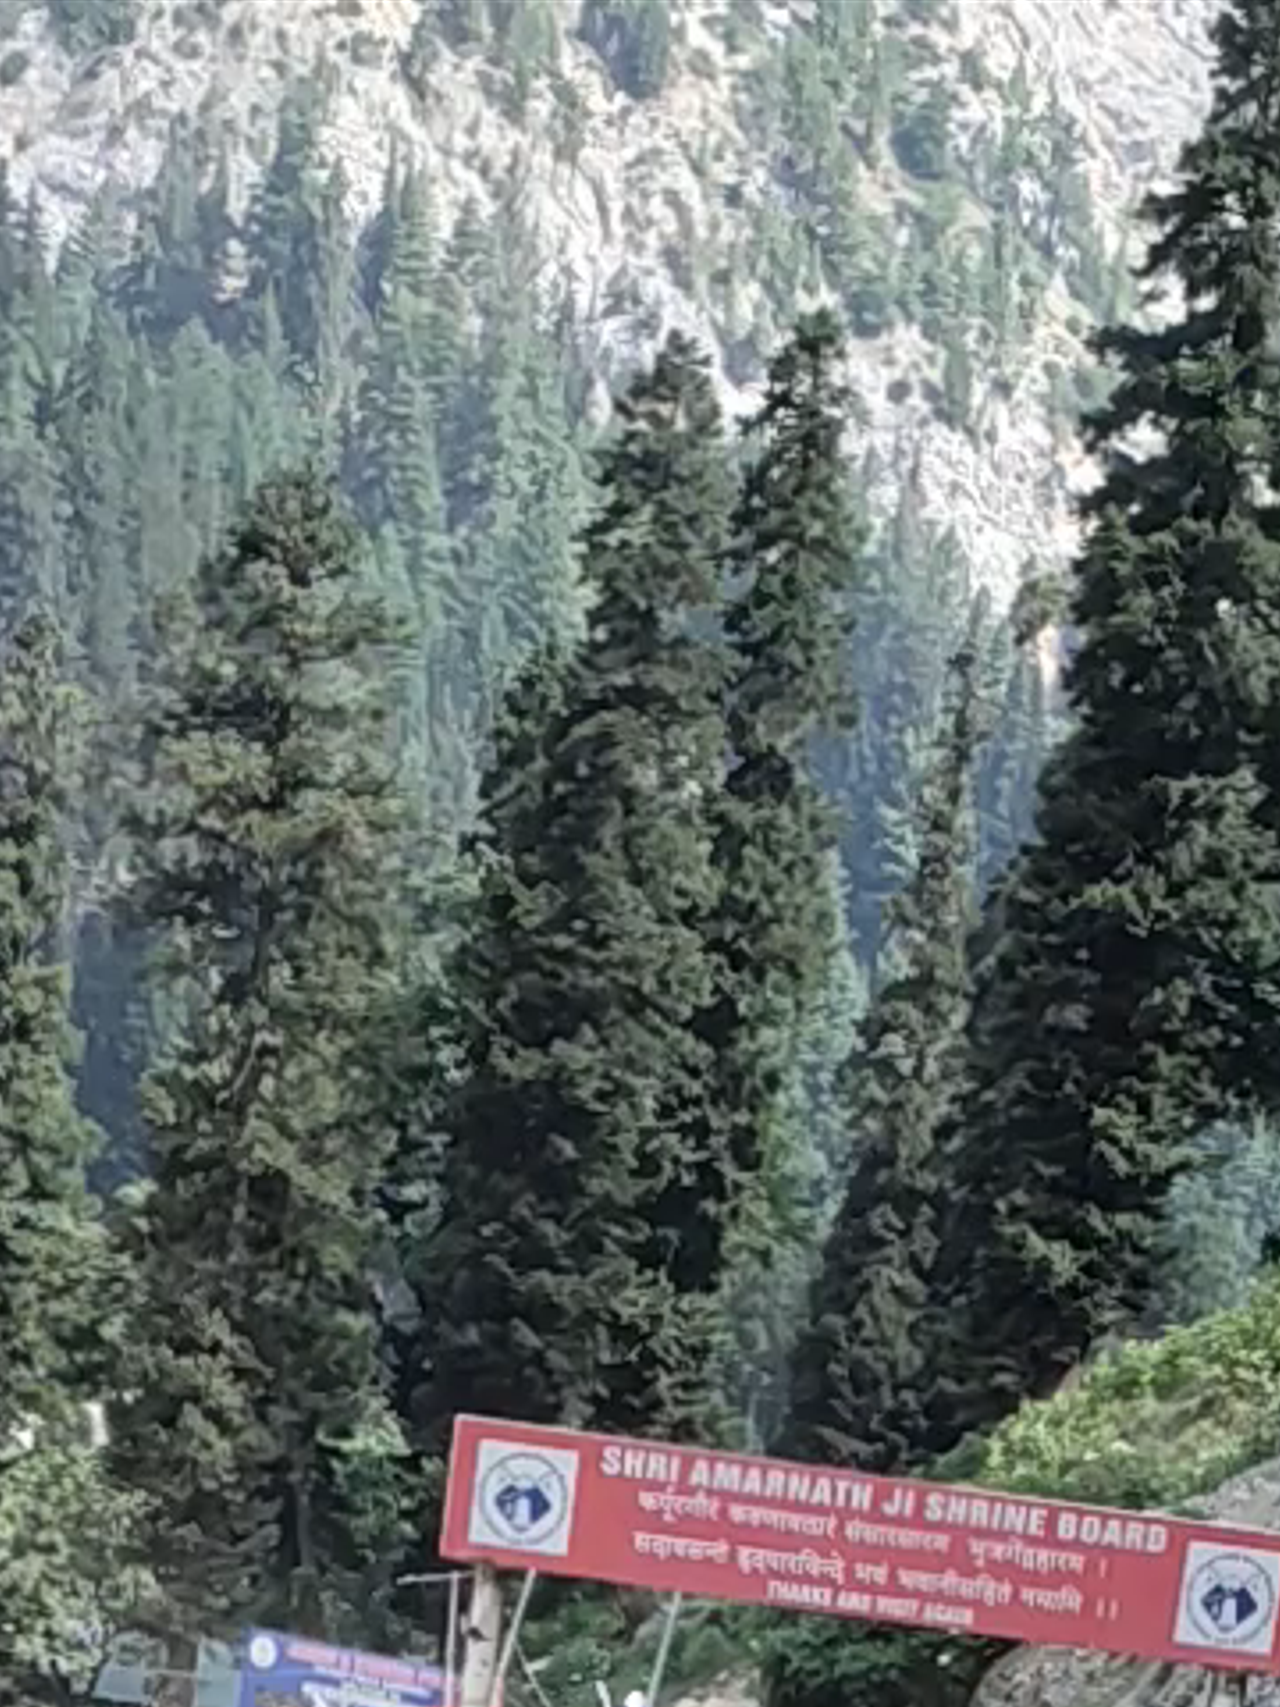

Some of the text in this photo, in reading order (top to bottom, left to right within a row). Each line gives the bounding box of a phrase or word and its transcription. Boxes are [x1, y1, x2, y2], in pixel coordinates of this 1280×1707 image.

[600, 1445, 1168, 1554] SHRI AMARNATH JI SHRINE BOARD
